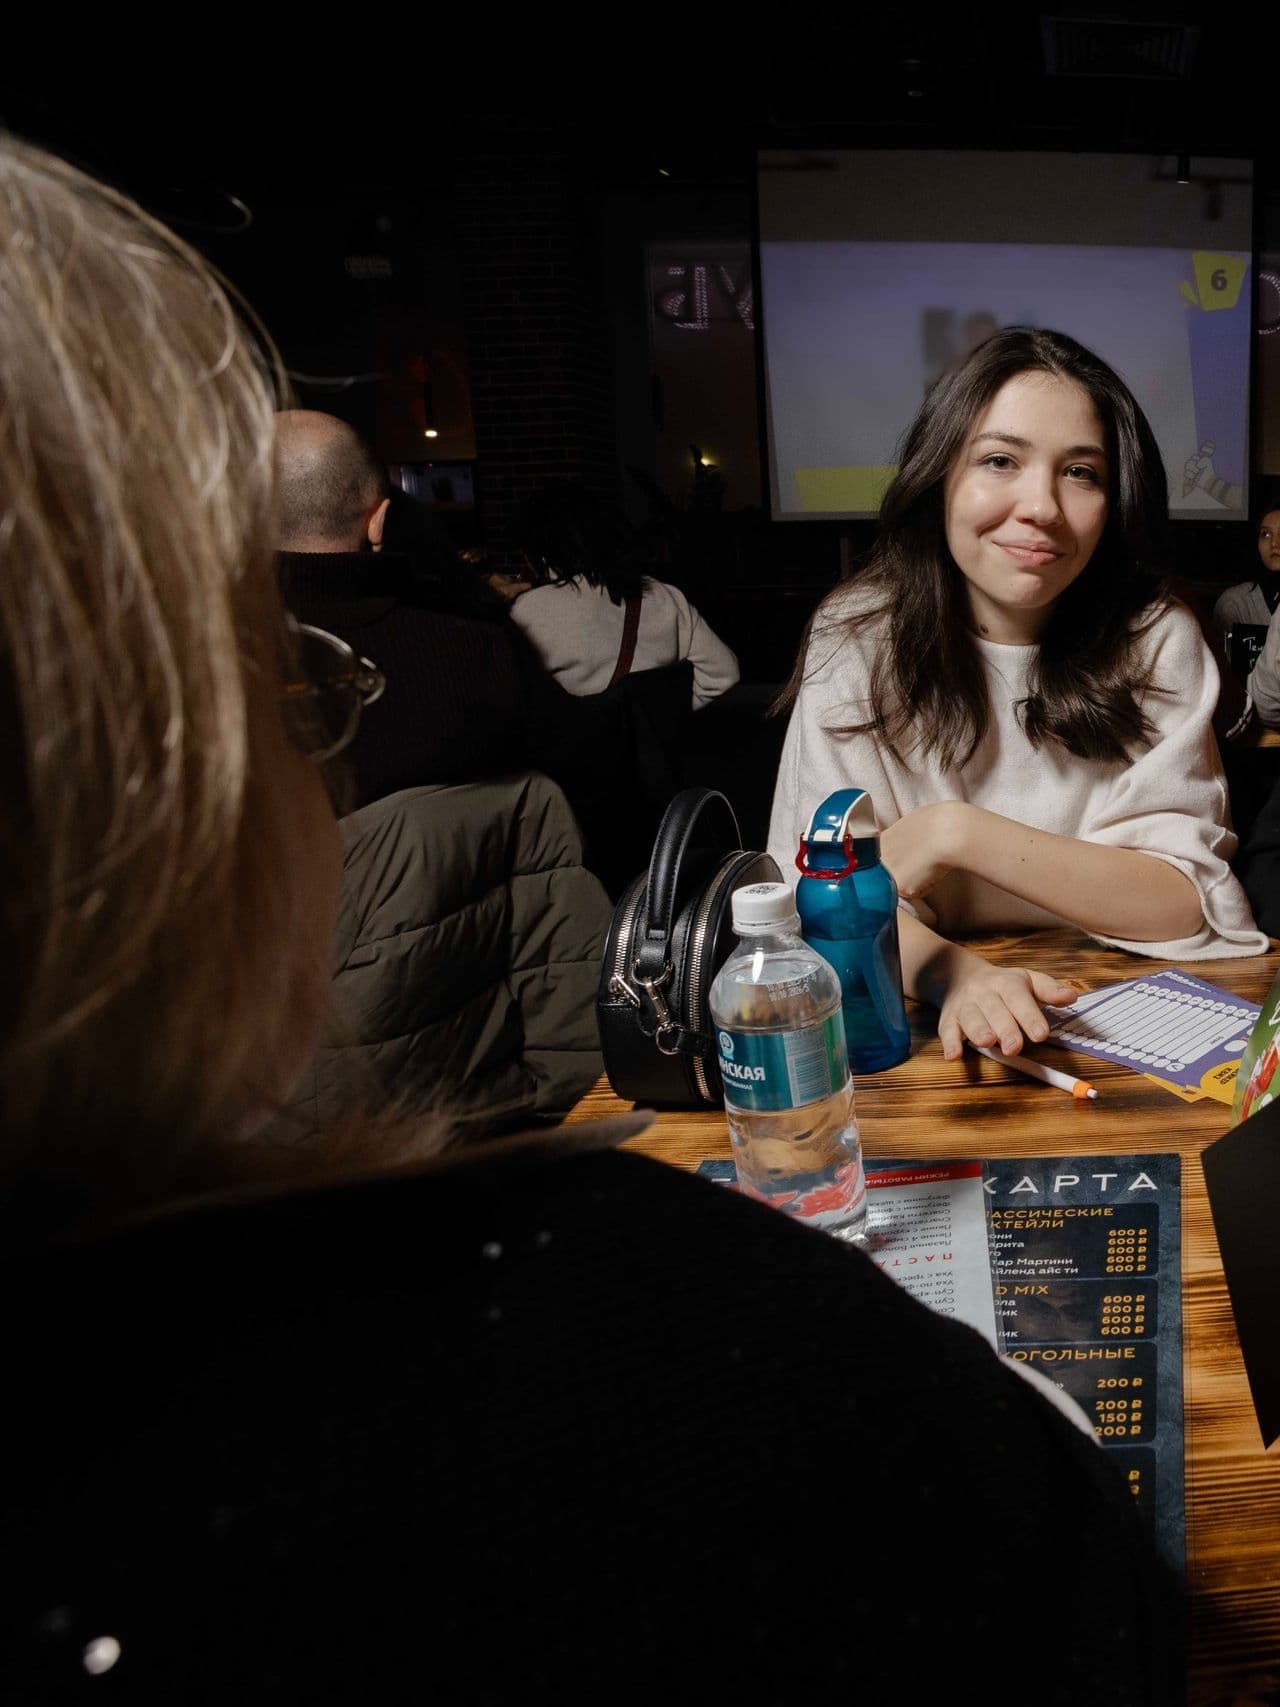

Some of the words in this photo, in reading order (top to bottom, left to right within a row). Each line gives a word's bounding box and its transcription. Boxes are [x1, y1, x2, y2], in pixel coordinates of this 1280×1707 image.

[1210, 269, 1228, 291] 6
[985, 1208, 1113, 1218] АССИЧЕСКИЕ
[990, 1219, 1064, 1229] КТЕЙЛИ
[1017, 1258, 1073, 1266] Мартини
[1107, 1256, 1134, 1264] 600
[1106, 1265, 1133, 1273] 600
[1014, 1285, 1049, 1295] MIX
[1104, 1296, 1132, 1304] 600
[1102, 1316, 1131, 1324] 600
[1101, 1327, 1131, 1335] 600
[1097, 1378, 1128, 1388] 200
[1096, 1400, 1127, 1410] 200
[1099, 1413, 1127, 1423] 150
[1095, 1426, 1126, 1436] 200
